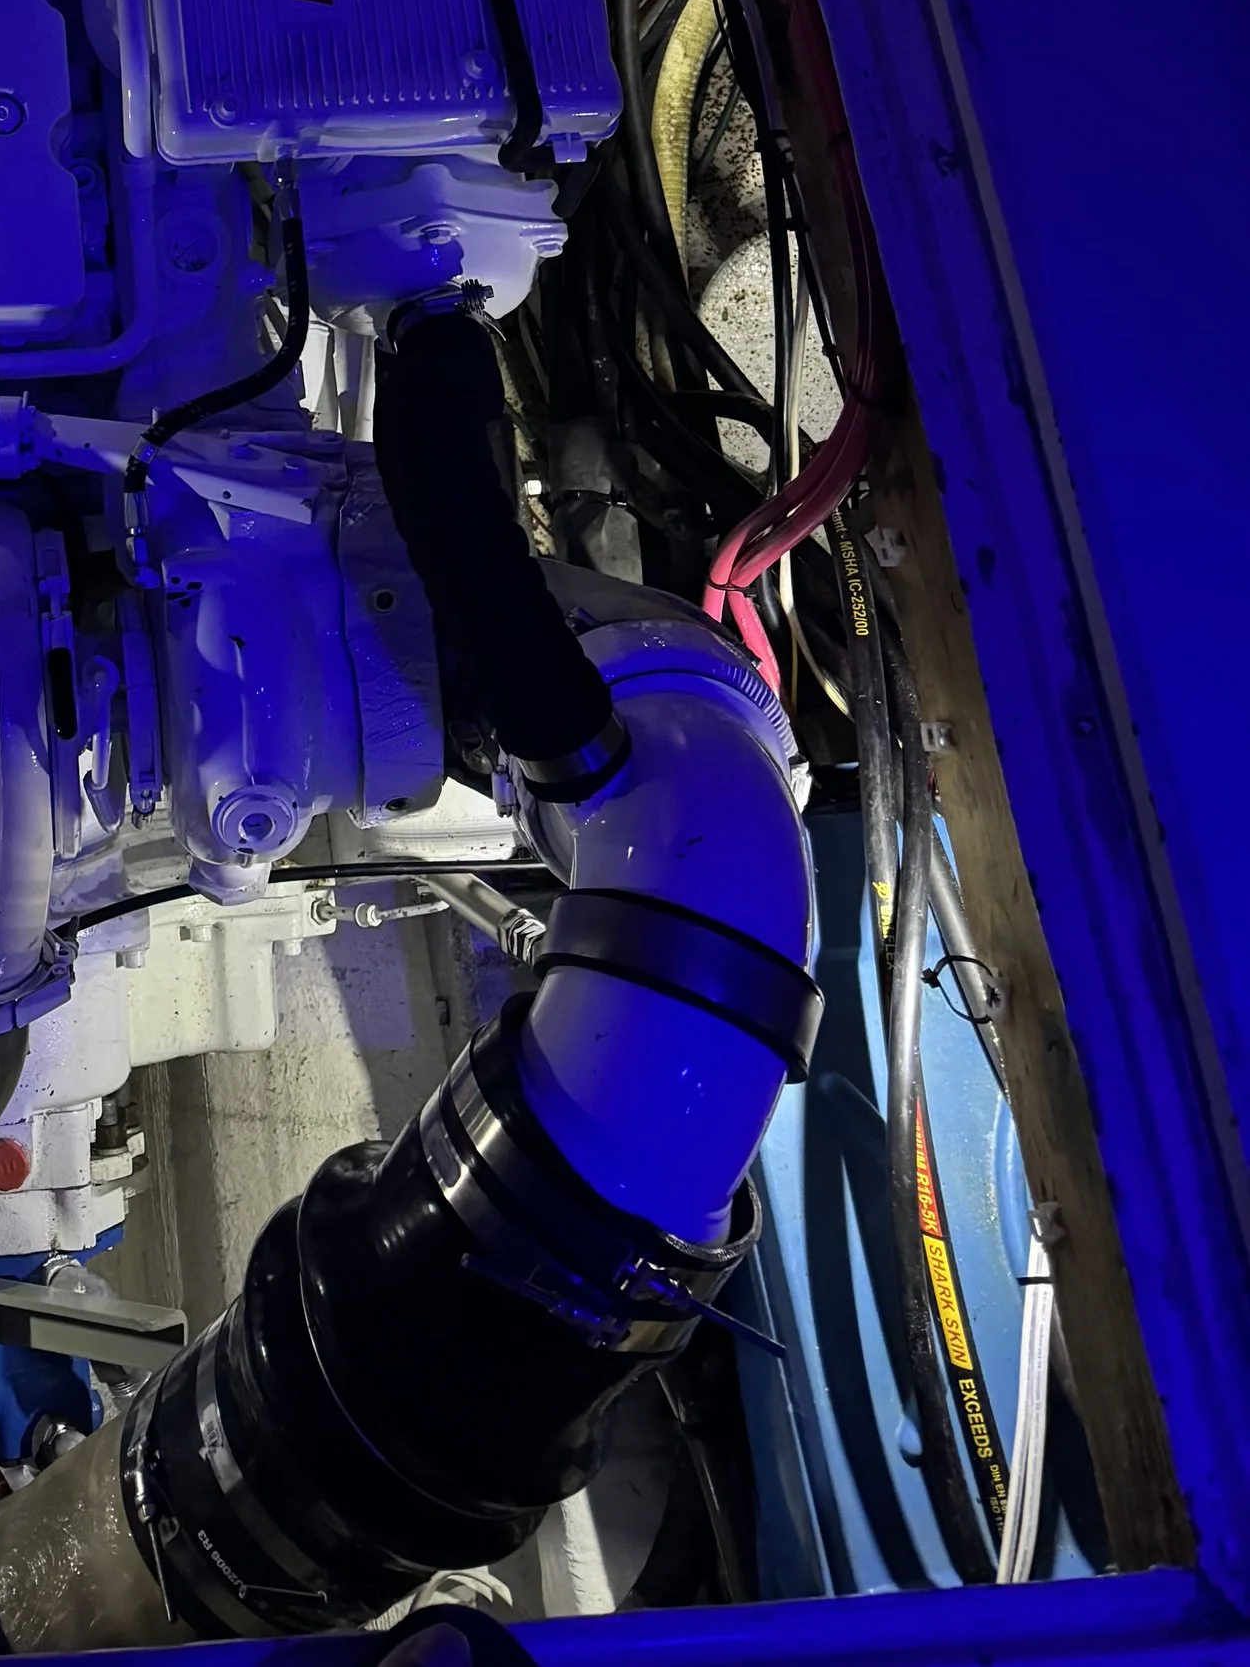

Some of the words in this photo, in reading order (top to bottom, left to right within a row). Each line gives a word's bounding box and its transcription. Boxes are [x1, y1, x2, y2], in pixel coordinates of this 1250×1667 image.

[839, 541, 859, 577] MSHA
[848, 579, 870, 636] IC-252/00
[916, 1173, 938, 1234] R16-5K
[929, 1245, 956, 1312] SHARK
[945, 1316, 968, 1363] SKIN
[958, 1378, 994, 1460] EXCEEDS
[989, 1463, 1003, 1482] DIN
[994, 1482, 1007, 1500] EN
